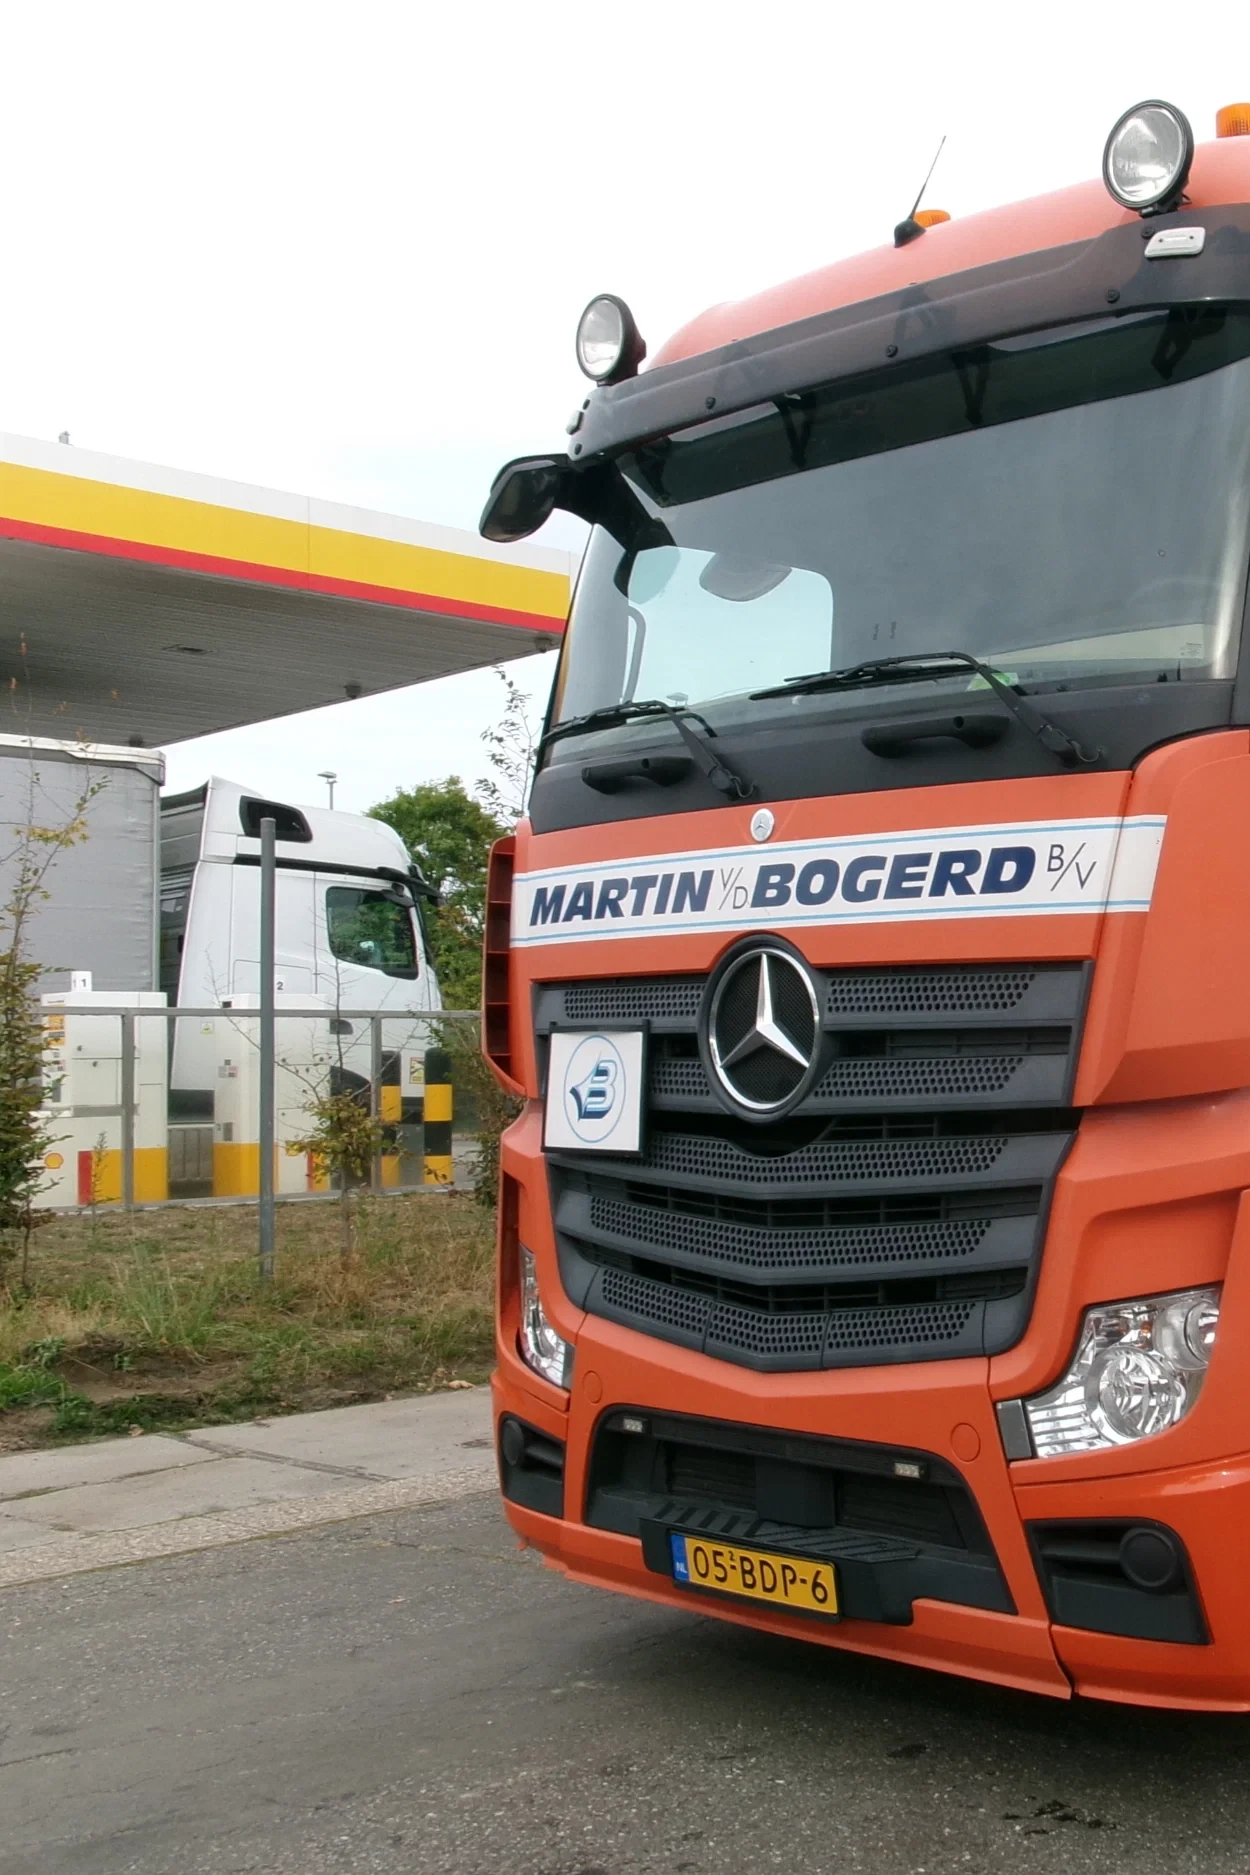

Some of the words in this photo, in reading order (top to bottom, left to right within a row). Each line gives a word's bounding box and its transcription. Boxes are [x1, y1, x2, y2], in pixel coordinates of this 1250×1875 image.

[529, 869, 715, 927] MARTIN
[750, 845, 1037, 908] BOGERD
[1047, 842, 1098, 892] B/V
[676, 1561, 688, 1574] NL
[693, 1545, 829, 1605] 05-BDP-6
